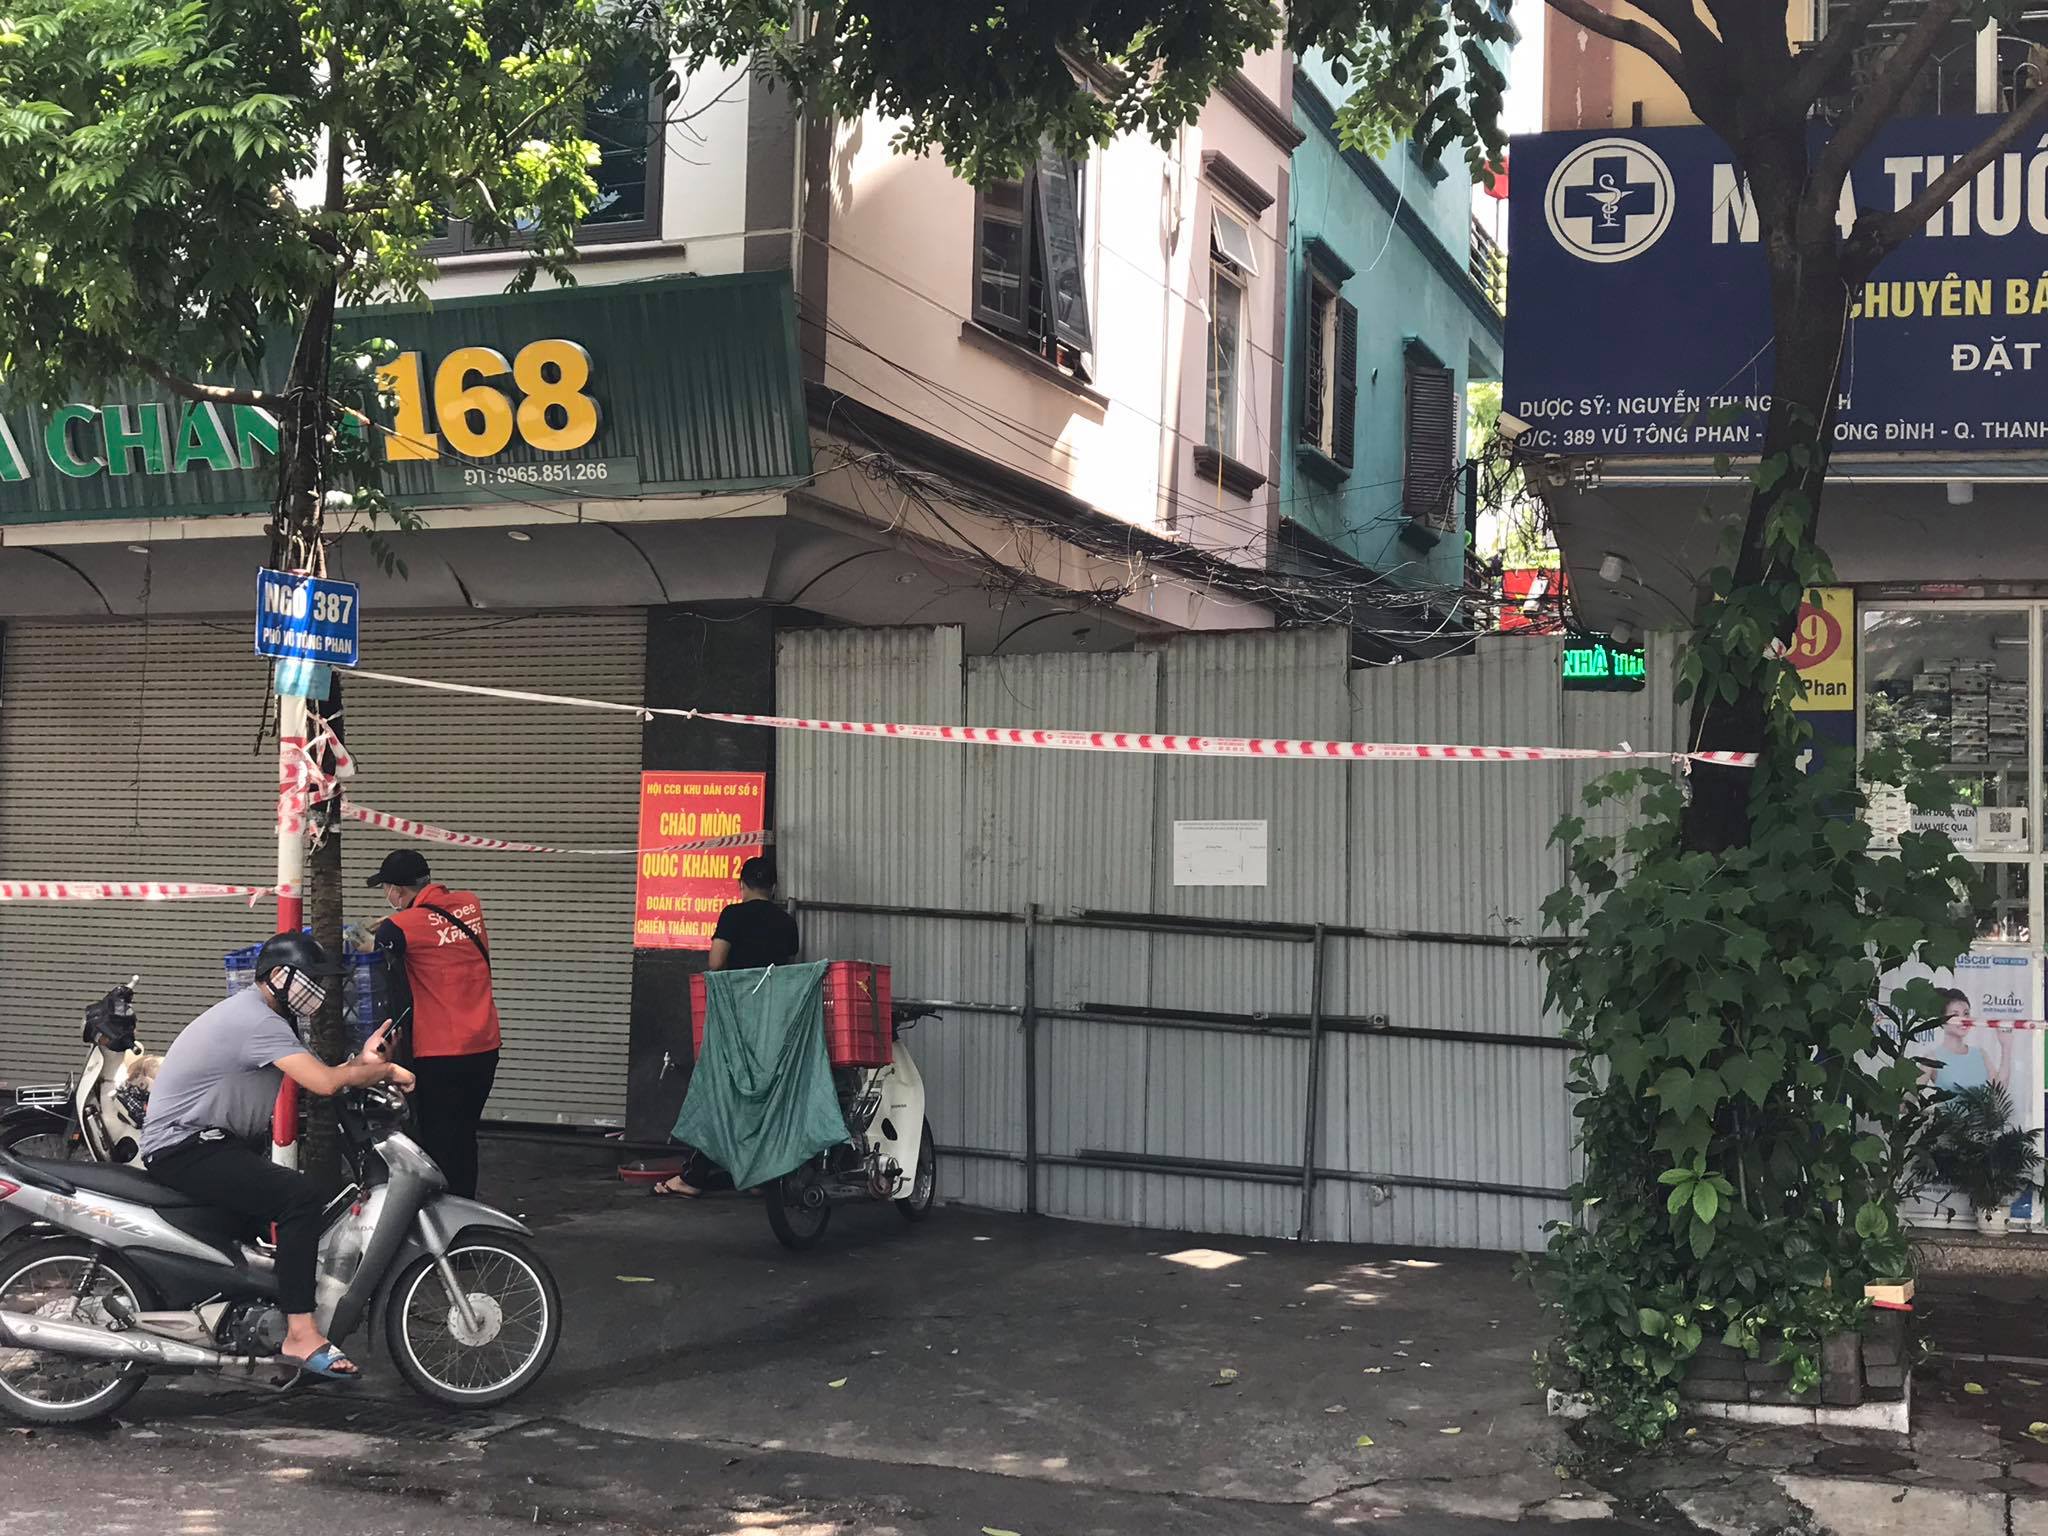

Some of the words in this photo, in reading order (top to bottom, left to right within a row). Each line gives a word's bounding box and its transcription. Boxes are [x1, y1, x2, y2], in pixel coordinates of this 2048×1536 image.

[1951, 335, 2041, 377] ĐẶT
[375, 339, 604, 461] 168
[1520, 399, 1573, 419] DƯỢC
[1618, 390, 1700, 414] NGUYỄN
[1563, 430, 1595, 445] 389
[1602, 425, 1627, 444] VŨ
[1695, 425, 1749, 443] PHAN
[1885, 419, 1935, 440] ĐÌNH
[1954, 422, 1975, 439] Q.
[498, 463, 608, 484] 0965.851.266
[313, 591, 353, 624] 387
[324, 636, 352, 654] PHAN
[1802, 679, 1847, 696] Phan
[647, 783, 661, 797] HỘI
[664, 784, 681, 795] CCB
[683, 784, 701, 796] KHU
[738, 781, 751, 797] SỐ
[752, 785, 758, 797] 8
[660, 808, 696, 836] CHÀO
[700, 808, 741, 837] MỪNG
[682, 850, 729, 879] KHÁNH
[646, 894, 673, 910] ĐOÀN
[675, 892, 692, 911] KẾT
[694, 893, 725, 913] QUYẾT
[637, 916, 665, 935] CHIẾN
[668, 916, 699, 936] THẮNG
